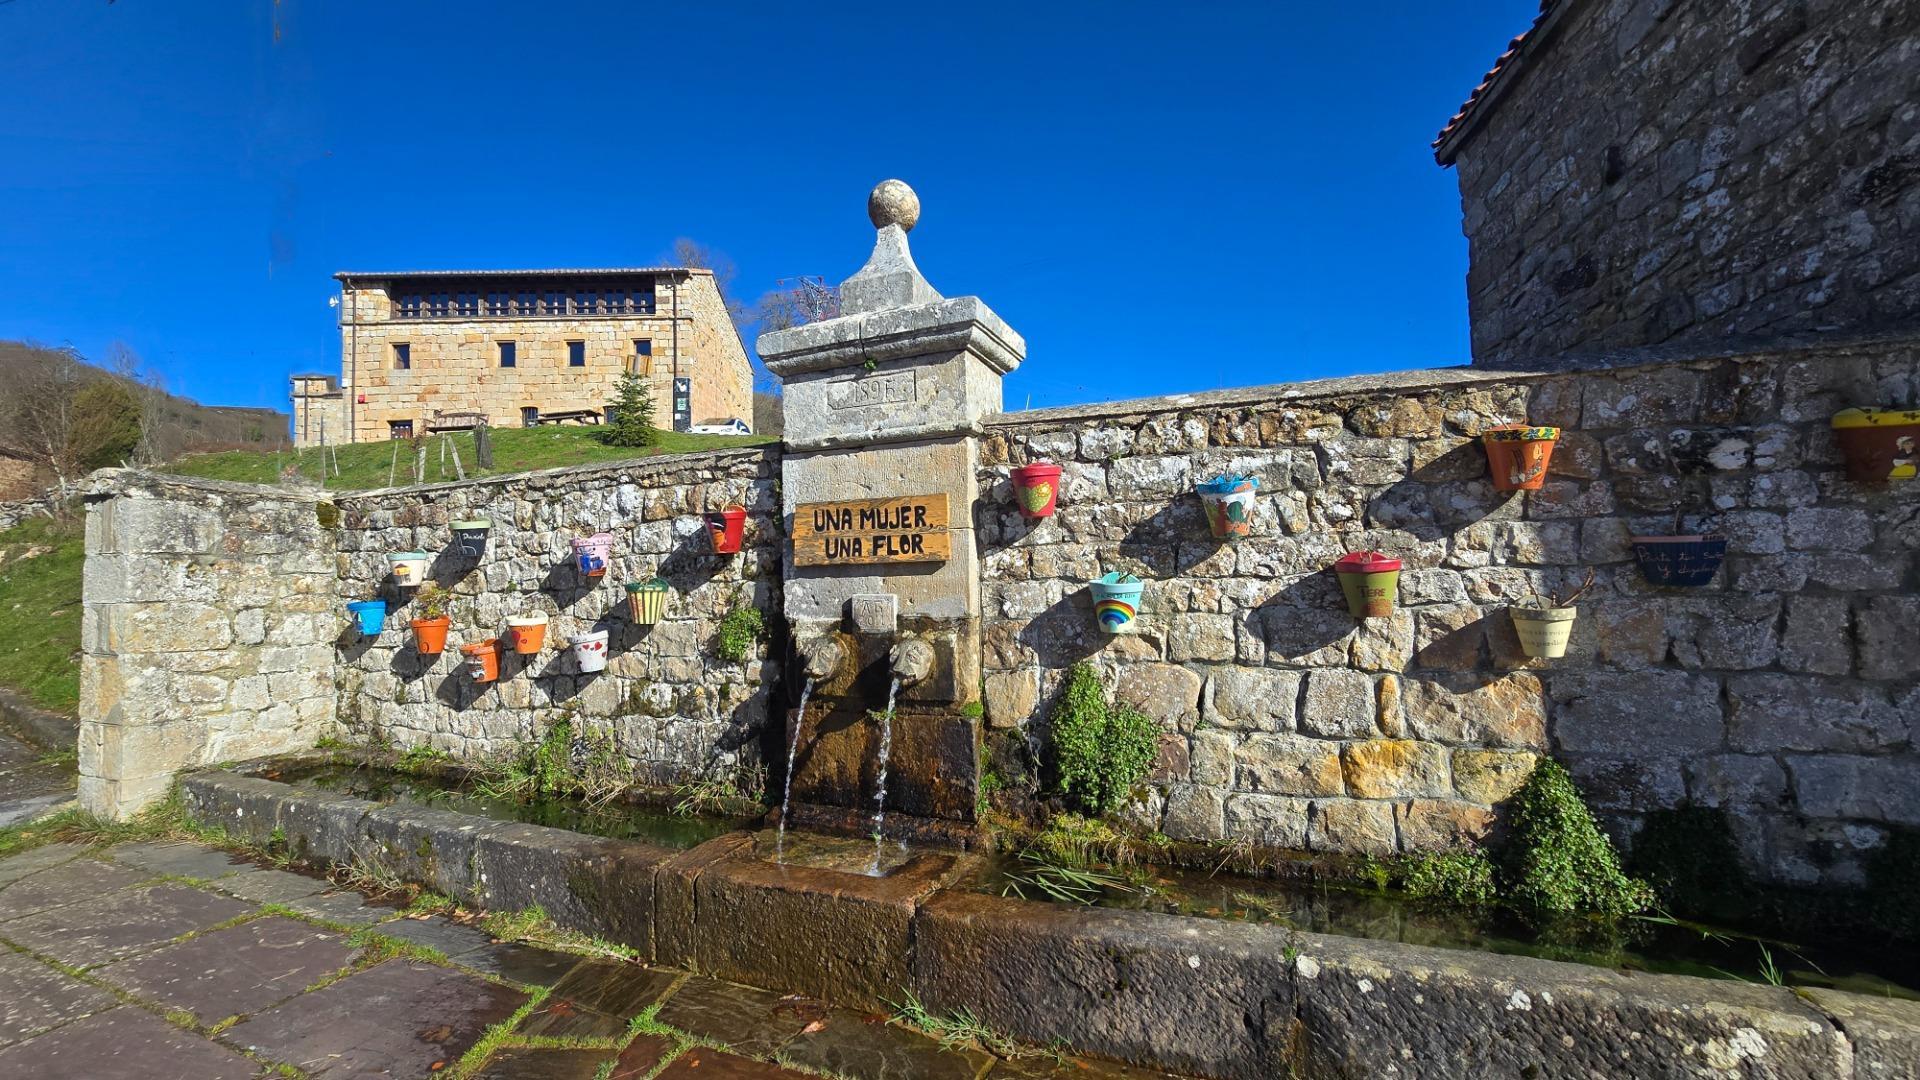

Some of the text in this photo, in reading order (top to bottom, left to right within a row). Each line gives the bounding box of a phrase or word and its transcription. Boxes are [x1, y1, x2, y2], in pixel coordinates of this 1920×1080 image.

[813, 505, 934, 532] UNA MUJER,
[825, 533, 924, 559] UNA FLOR
